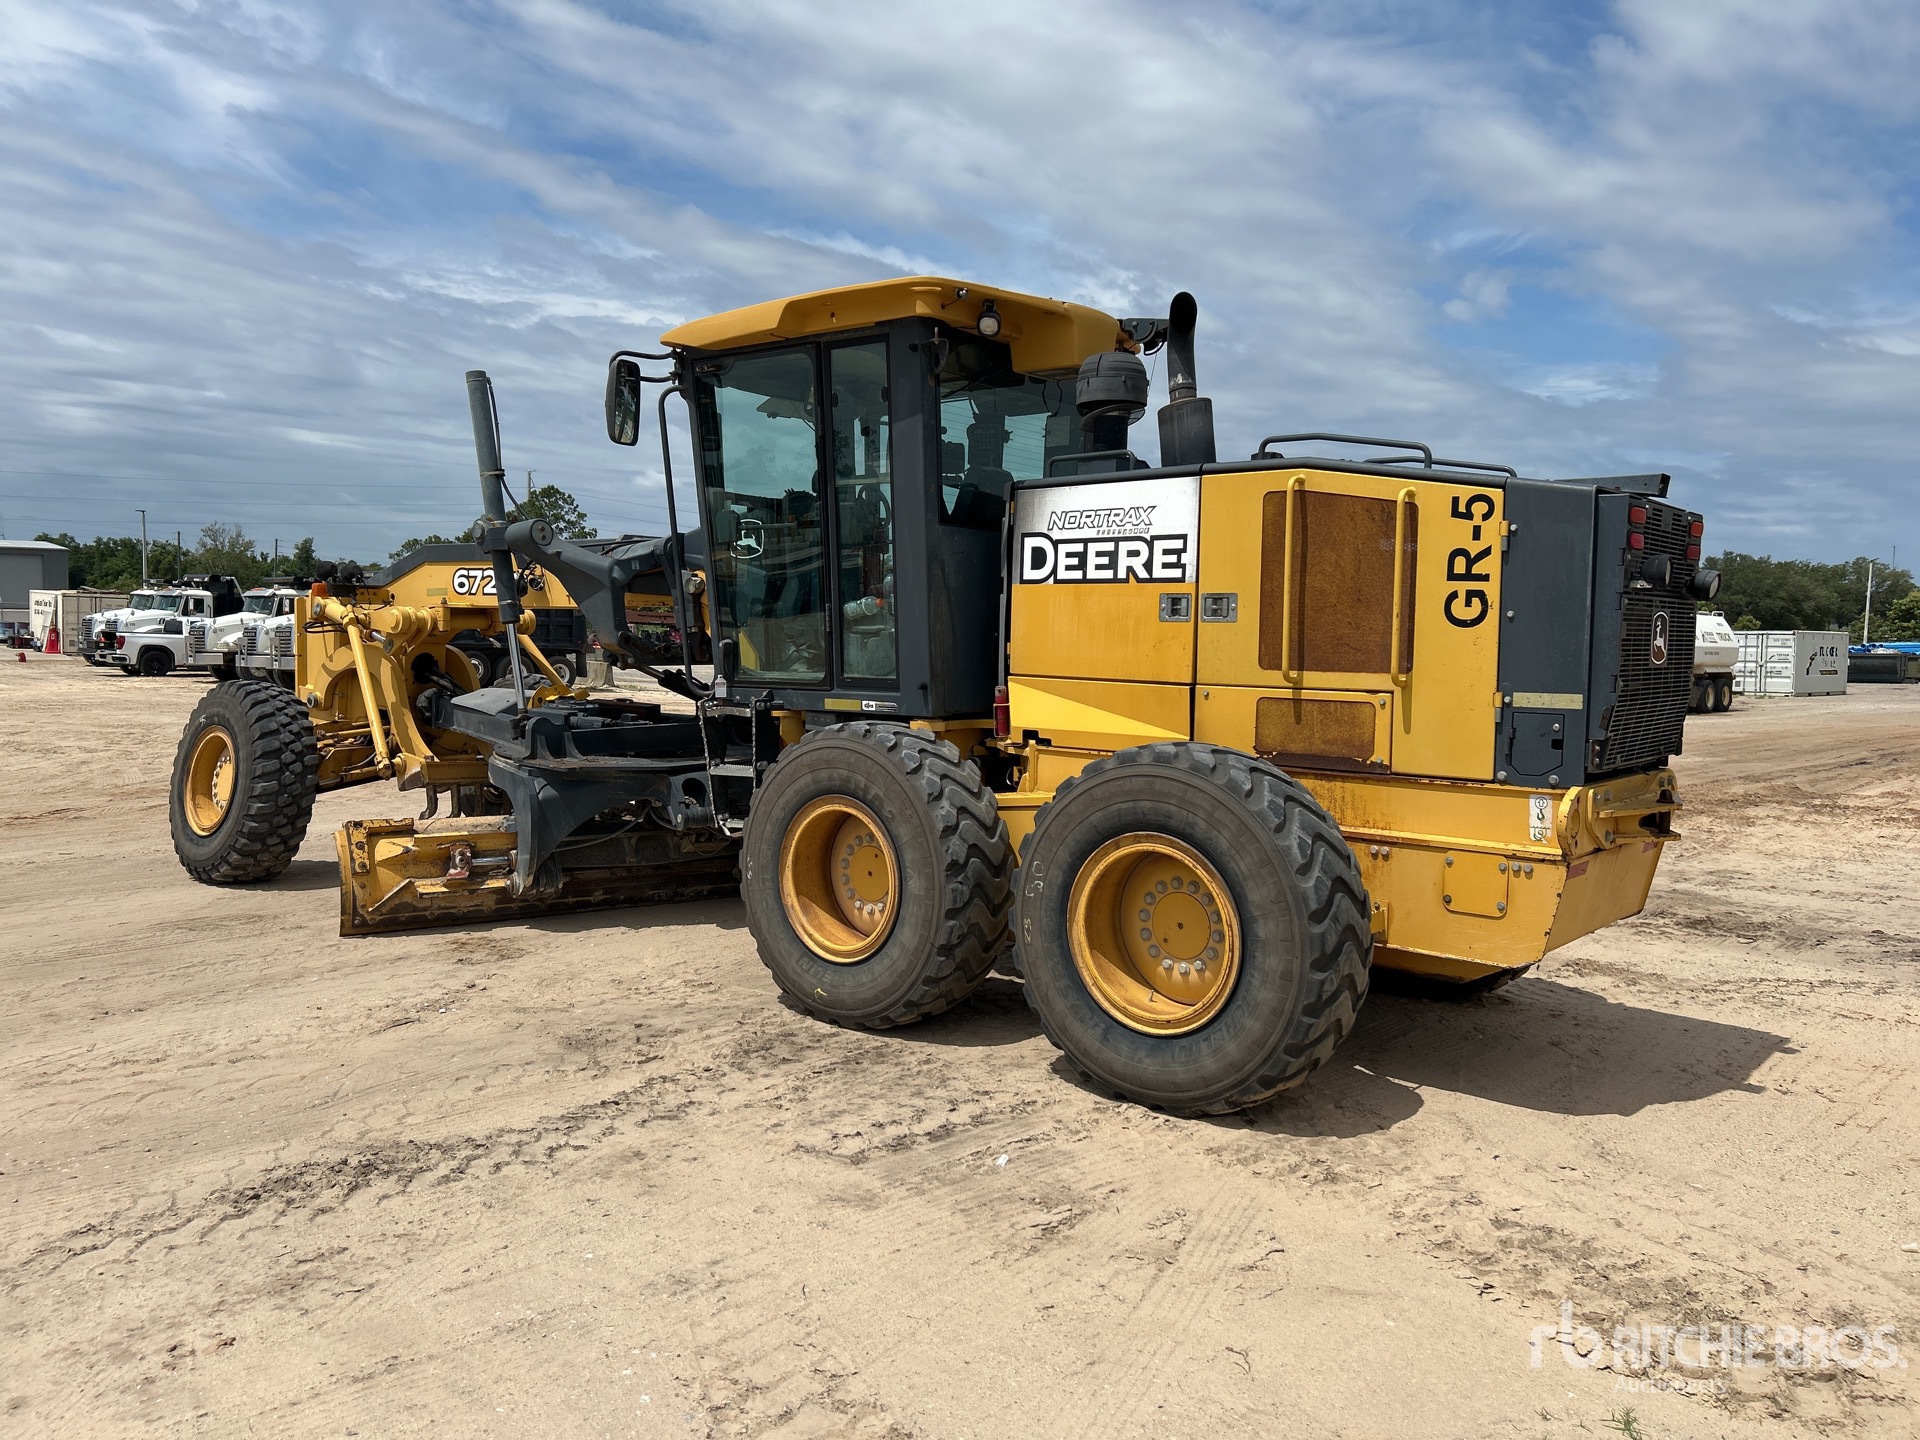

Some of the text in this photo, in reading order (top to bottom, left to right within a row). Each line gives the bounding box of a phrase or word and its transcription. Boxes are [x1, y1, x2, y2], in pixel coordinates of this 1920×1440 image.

[1047, 505, 1158, 531] NORTRAX
[1019, 531, 1188, 585] DEERE
[1443, 493, 1496, 629] GR-5
